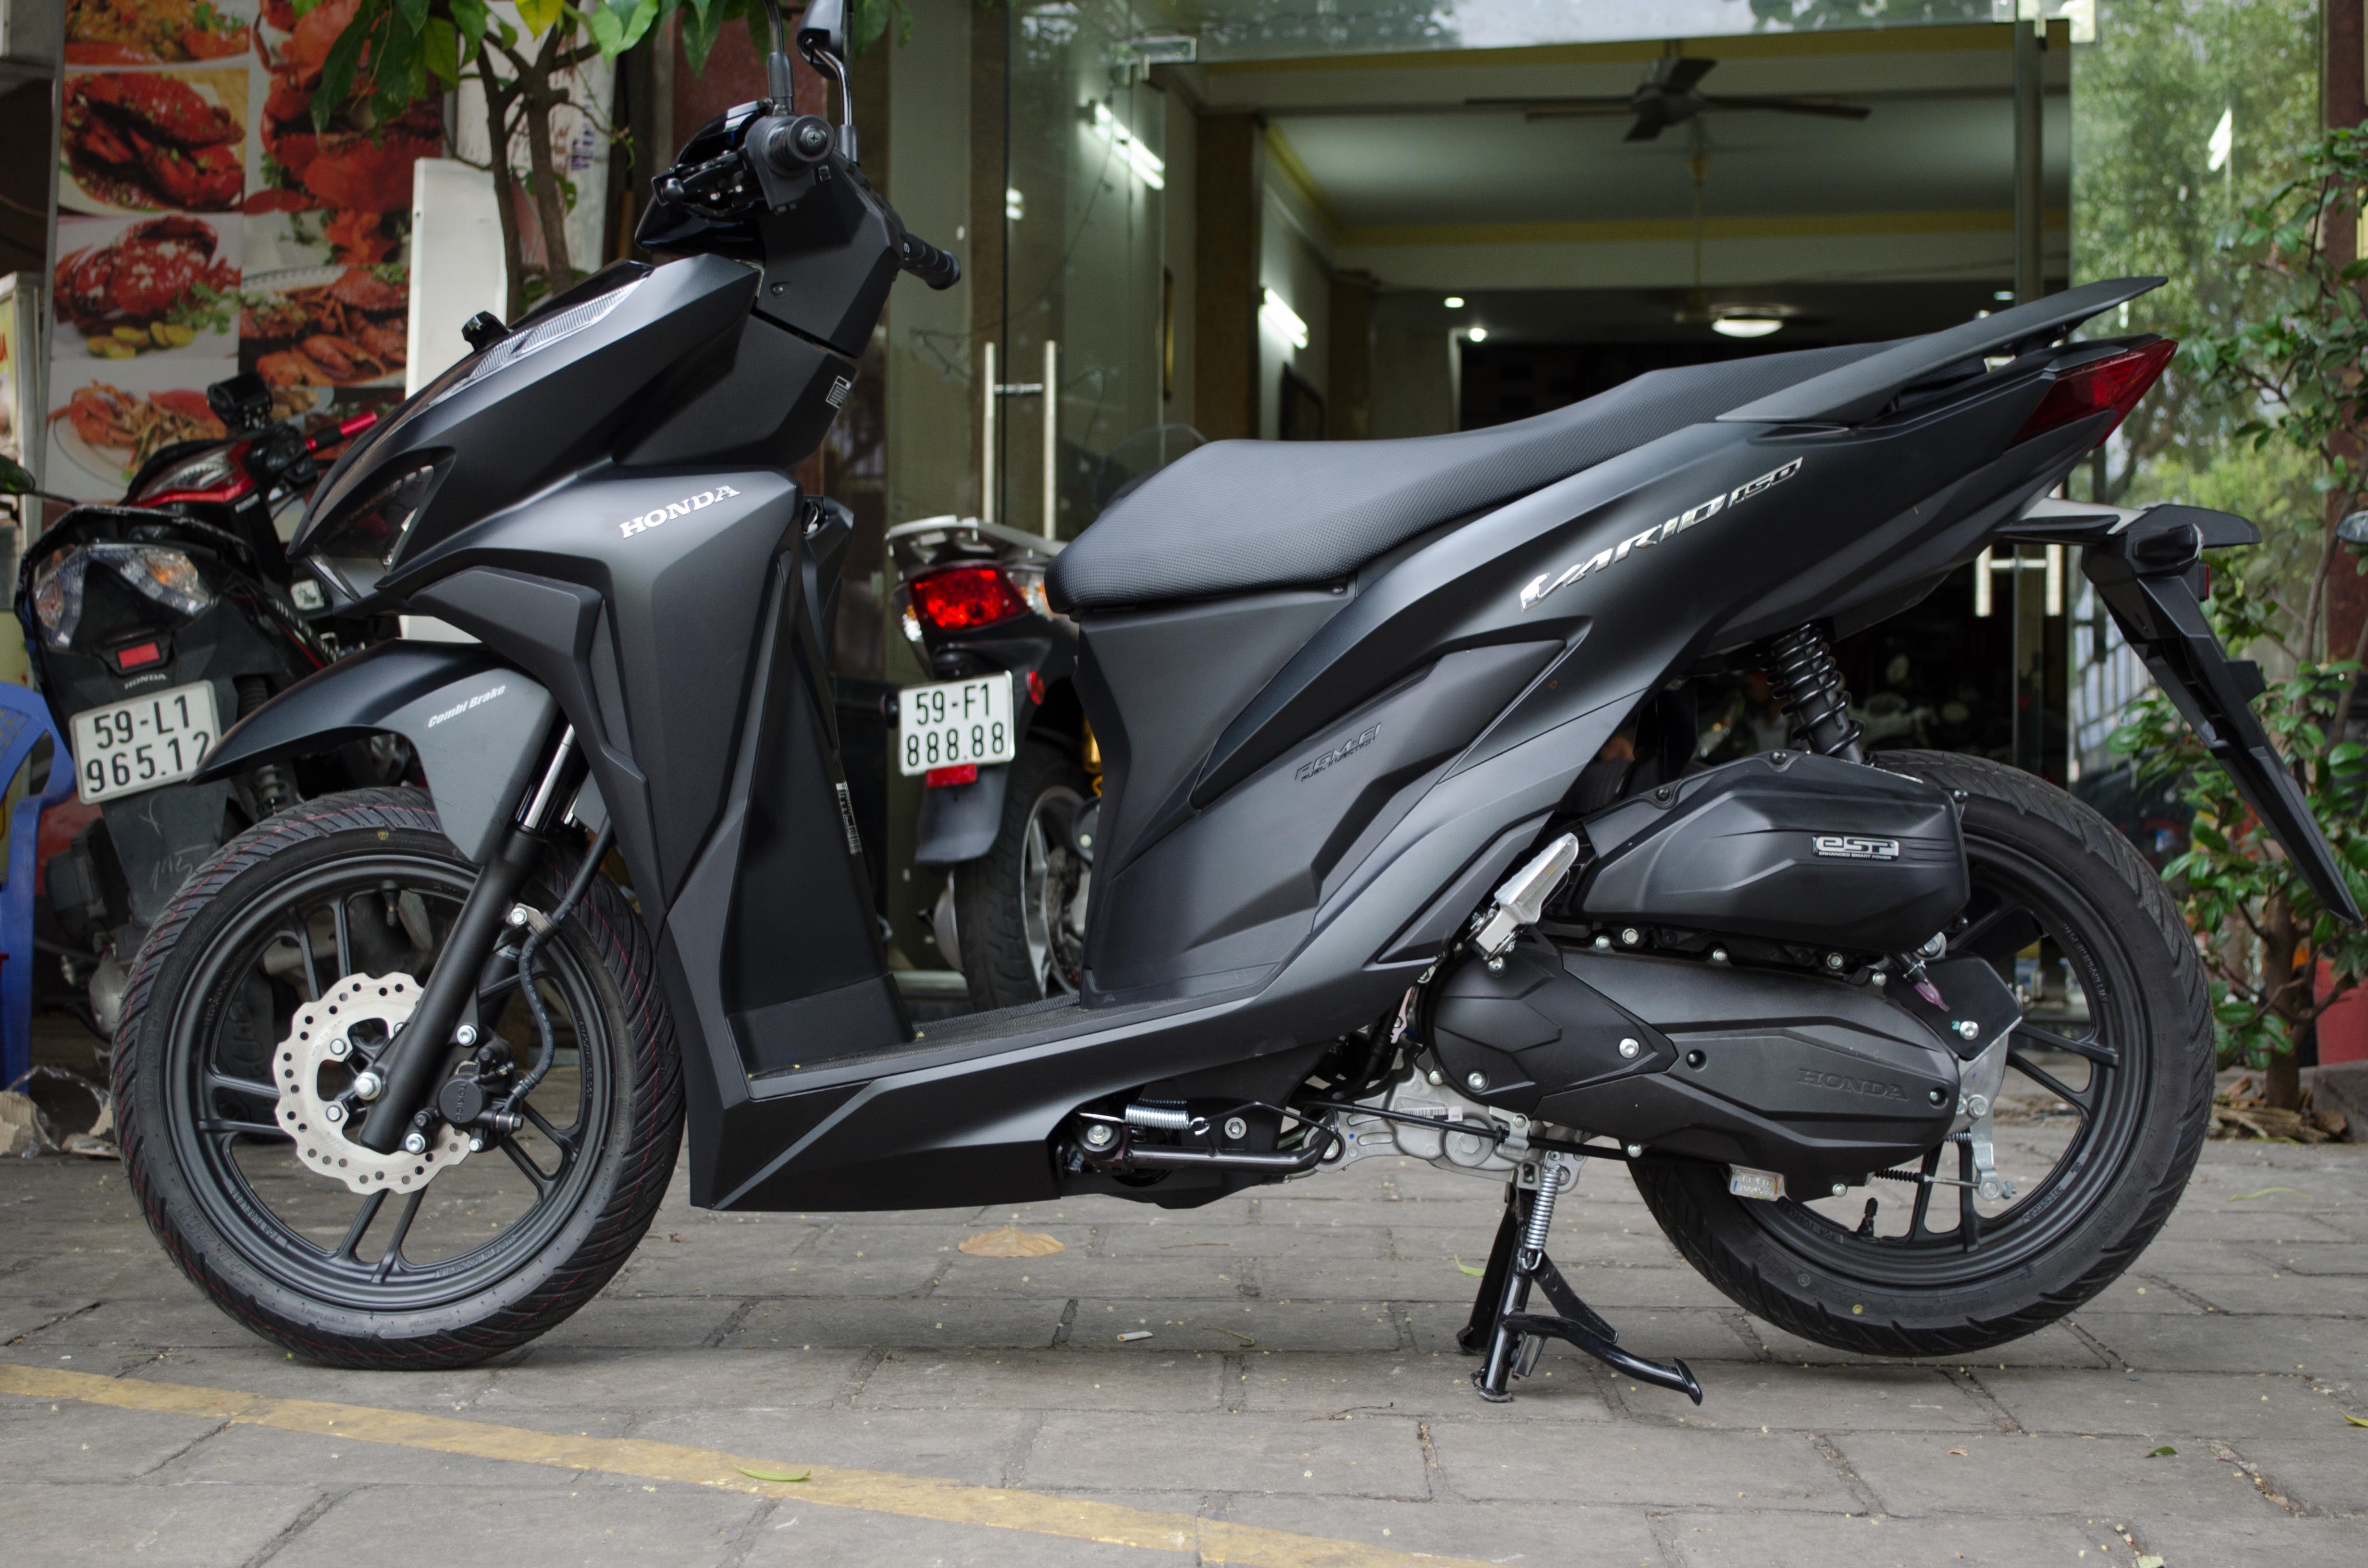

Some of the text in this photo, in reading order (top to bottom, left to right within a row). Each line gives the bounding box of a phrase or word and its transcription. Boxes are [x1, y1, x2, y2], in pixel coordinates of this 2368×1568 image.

[620, 485, 740, 539] HONDA
[1519, 456, 1803, 612] VARIO 150
[123, 673, 167, 690] HONDA
[93, 694, 190, 749] 59-L1
[428, 685, 506, 728] Combi Brake
[916, 682, 989, 725] 59-F1
[907, 722, 1004, 766] 888.88
[1301, 736, 1375, 782] FUEL INJECTION
[455, 1082, 468, 1121] TOKICO
[1798, 1068, 1908, 1102] HONDA
[231, 1188, 279, 1241] FOR TUBELESS
[2023, 1185, 2063, 1221] HONDA
[408, 1317, 443, 1328] ROTATION
